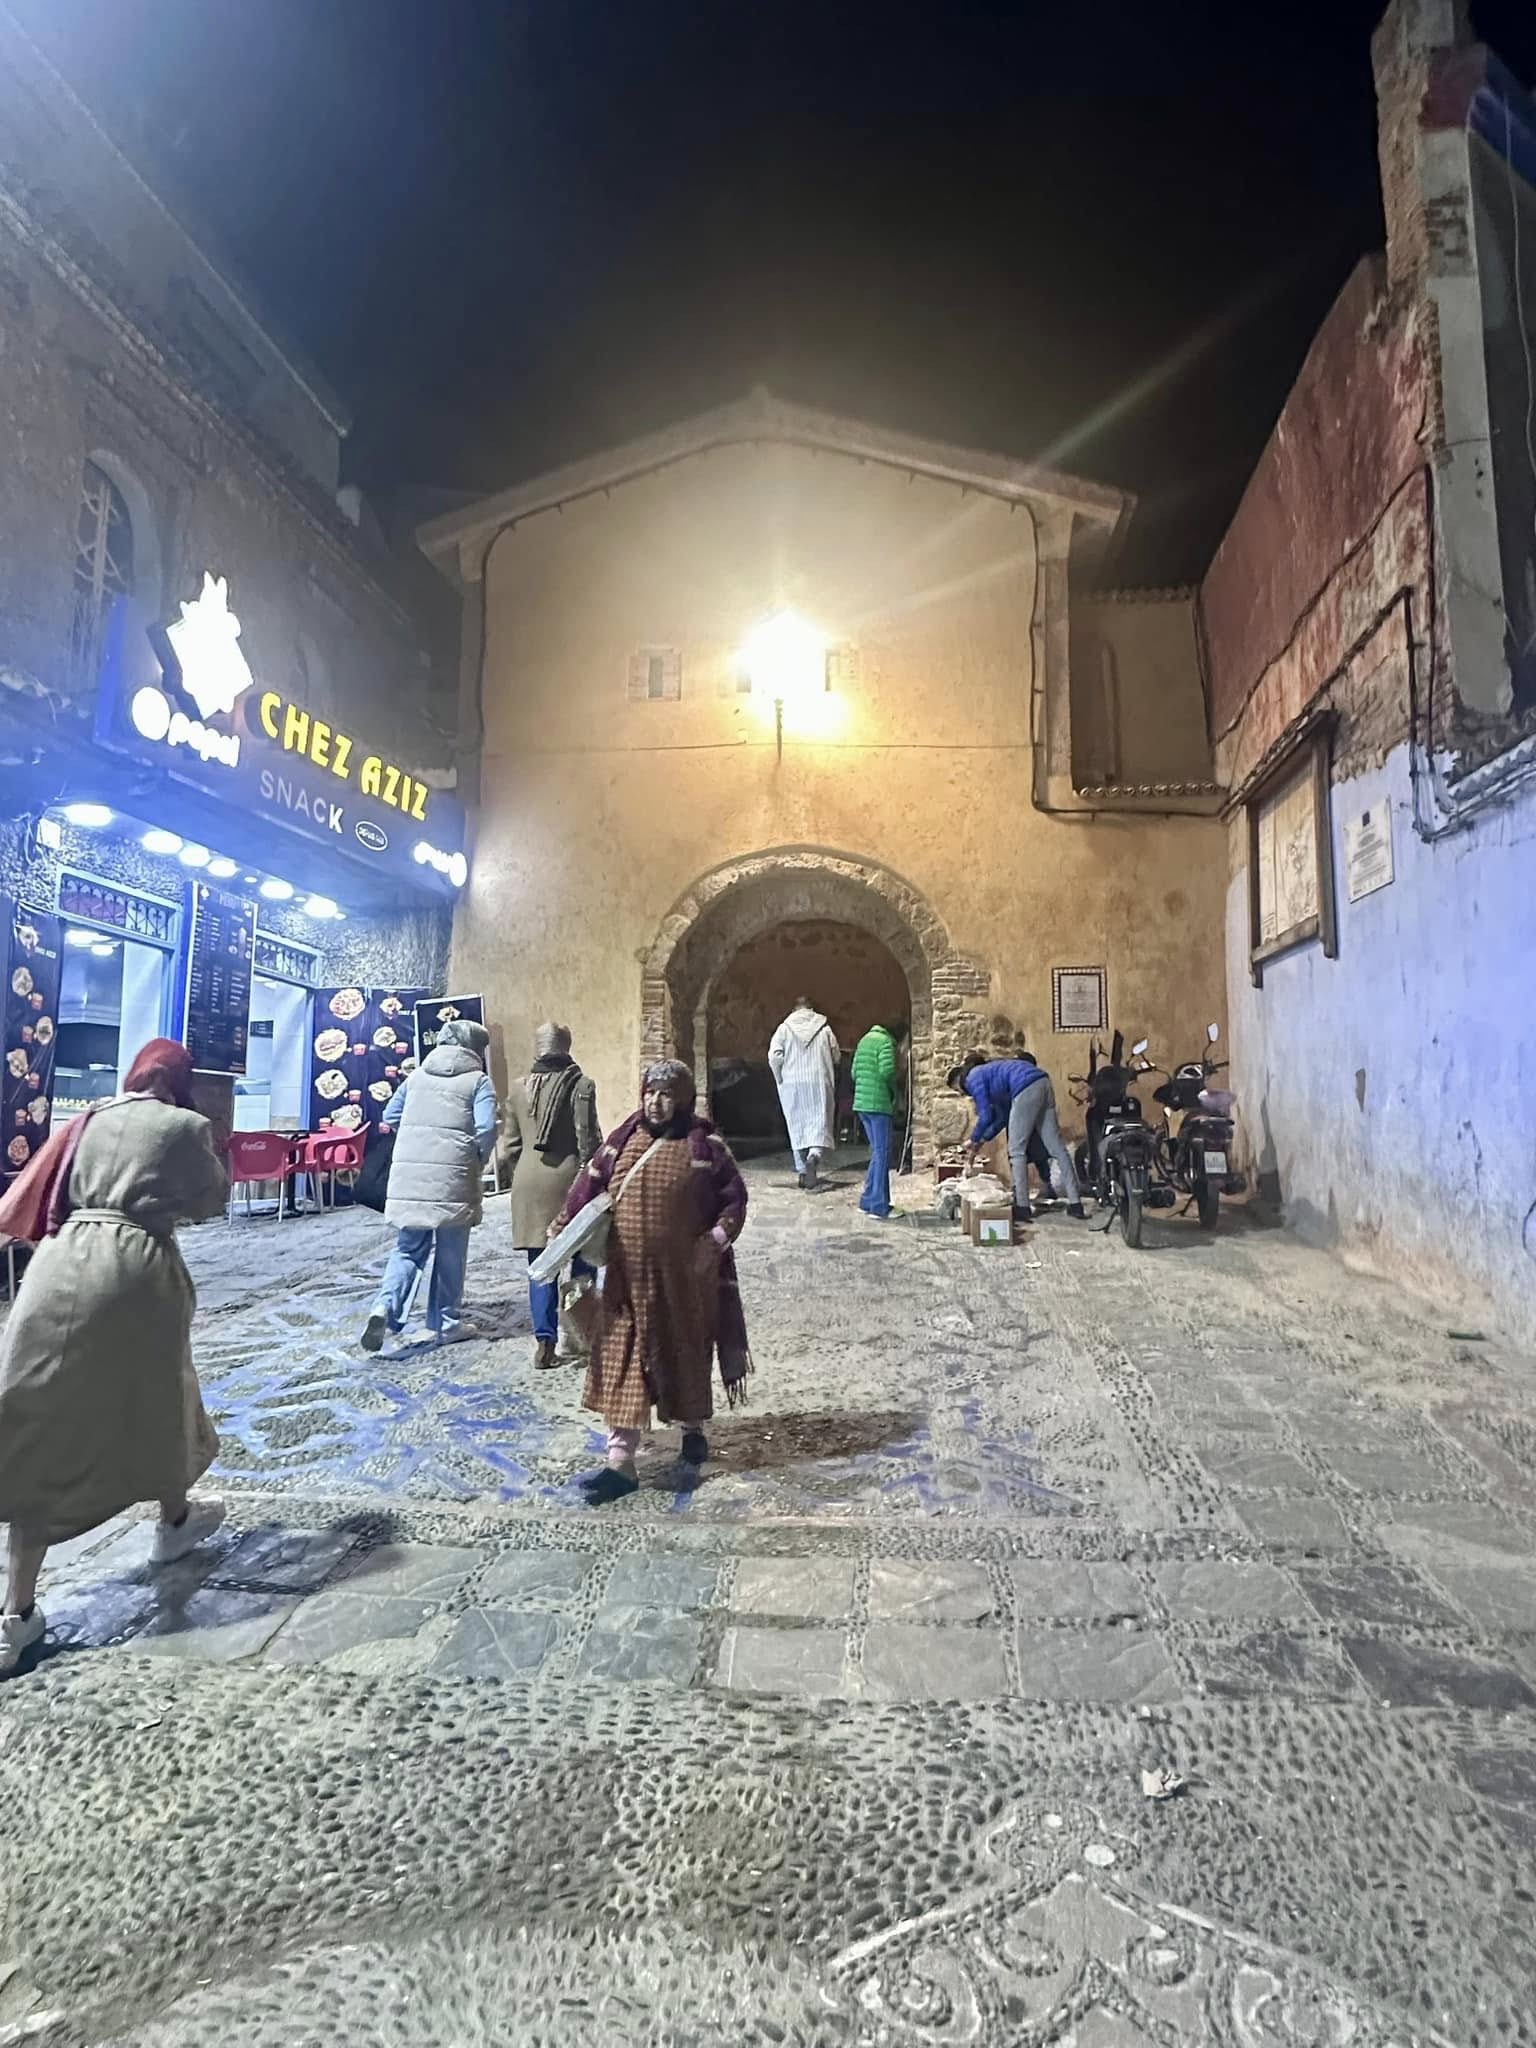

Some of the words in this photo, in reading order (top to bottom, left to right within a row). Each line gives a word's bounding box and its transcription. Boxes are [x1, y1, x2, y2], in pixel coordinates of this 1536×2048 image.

[259, 768, 345, 834] SNACK
[260, 692, 353, 779] CHEZ
[360, 756, 428, 821] AZIZ
